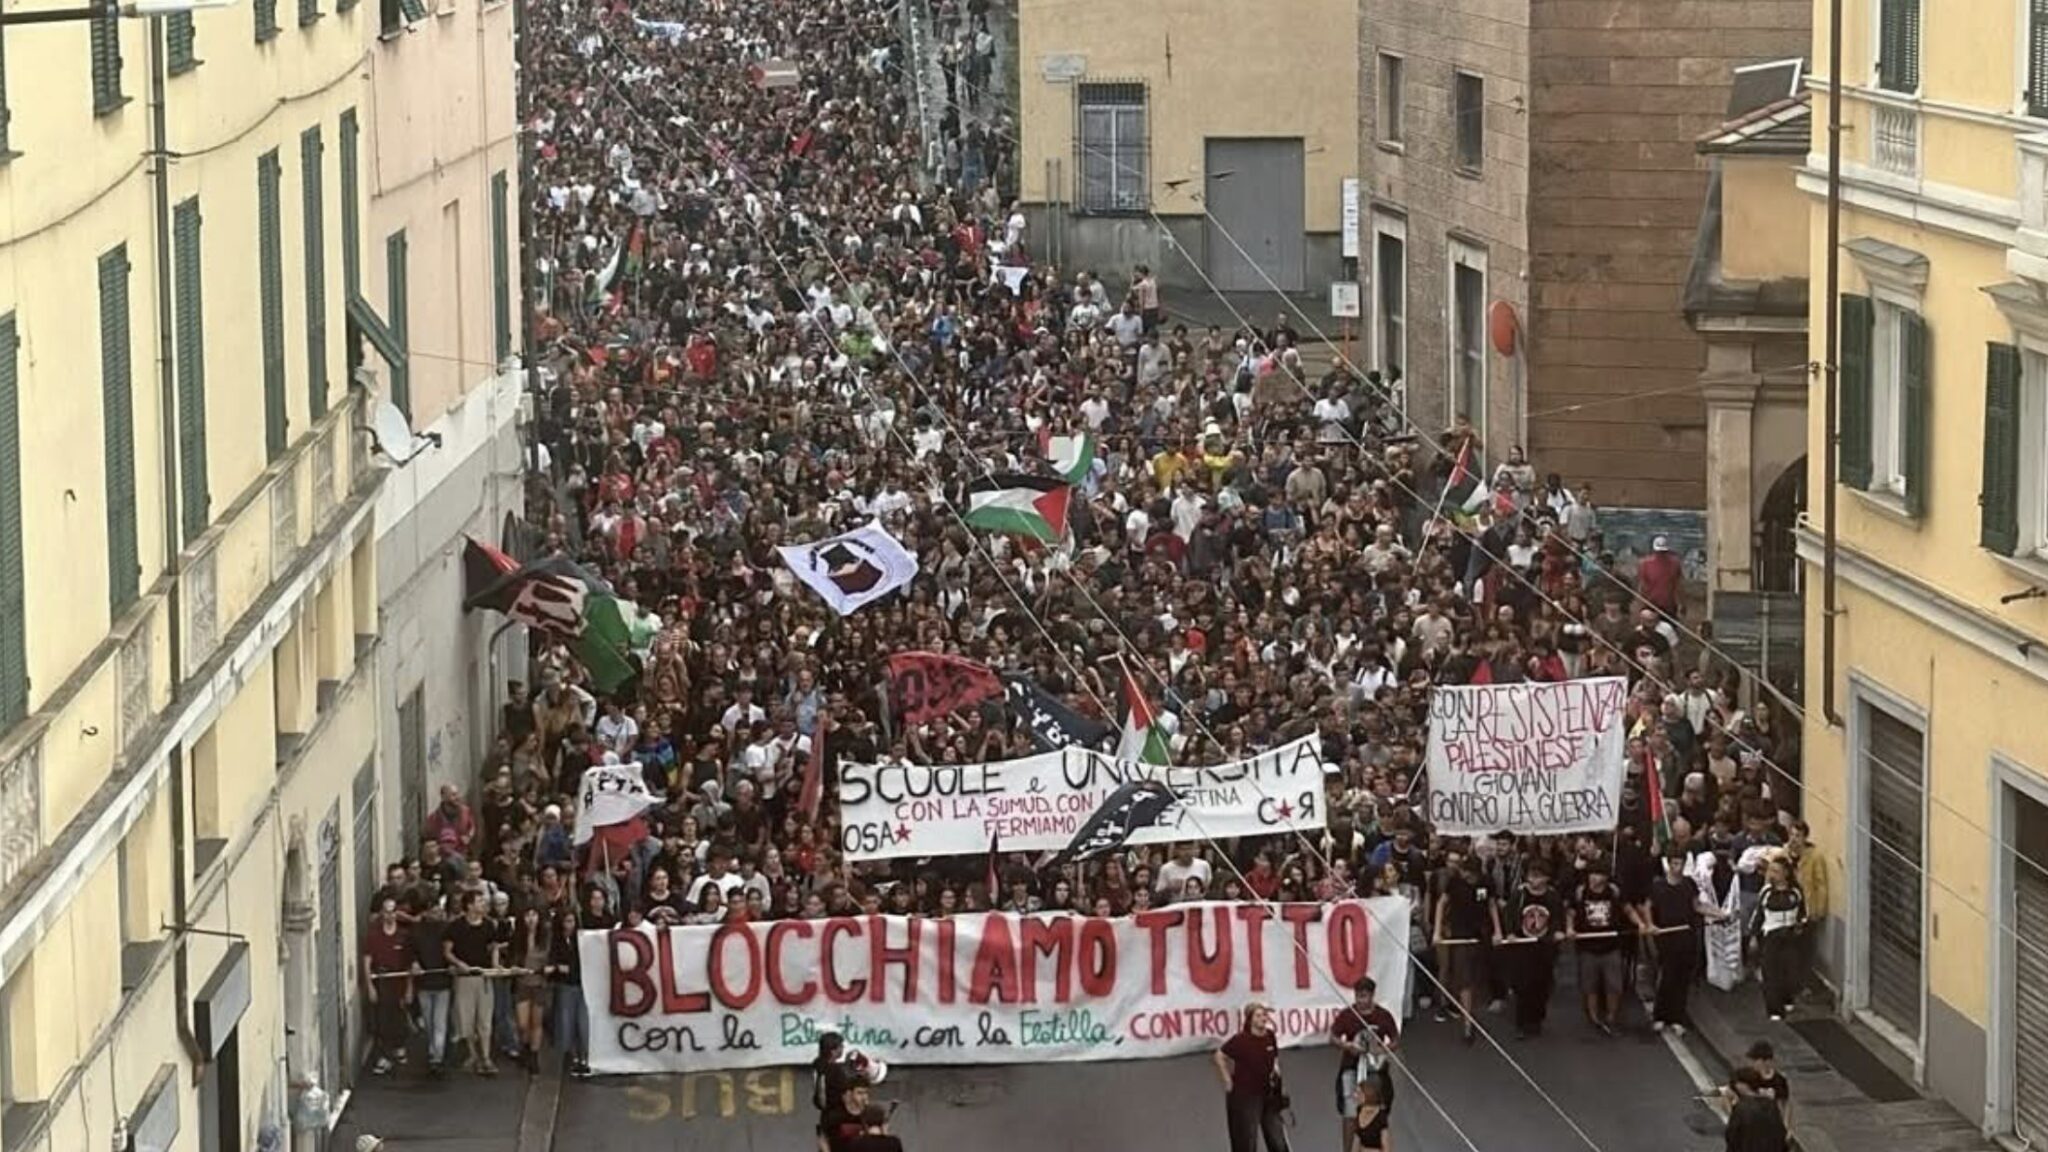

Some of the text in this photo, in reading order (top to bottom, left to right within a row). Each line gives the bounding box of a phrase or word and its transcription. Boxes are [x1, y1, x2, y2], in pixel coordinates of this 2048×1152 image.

[1431, 688, 1473, 720] CON
[840, 763, 1005, 805] SCUOLE
[895, 799, 943, 822] CON
[953, 796, 982, 819] LA
[1057, 792, 1094, 813] CON
[1430, 787, 1613, 826] CONTRO LA GUERRA
[984, 815, 1076, 839] FERMIAMO
[608, 903, 1370, 1018] BLOCCHIAMO TUTTO
[618, 1021, 704, 1052] con
[717, 1014, 761, 1051] la
[915, 1025, 963, 1047] con
[976, 1011, 1012, 1046] la
[1131, 1008, 1229, 1040] CONTRO
